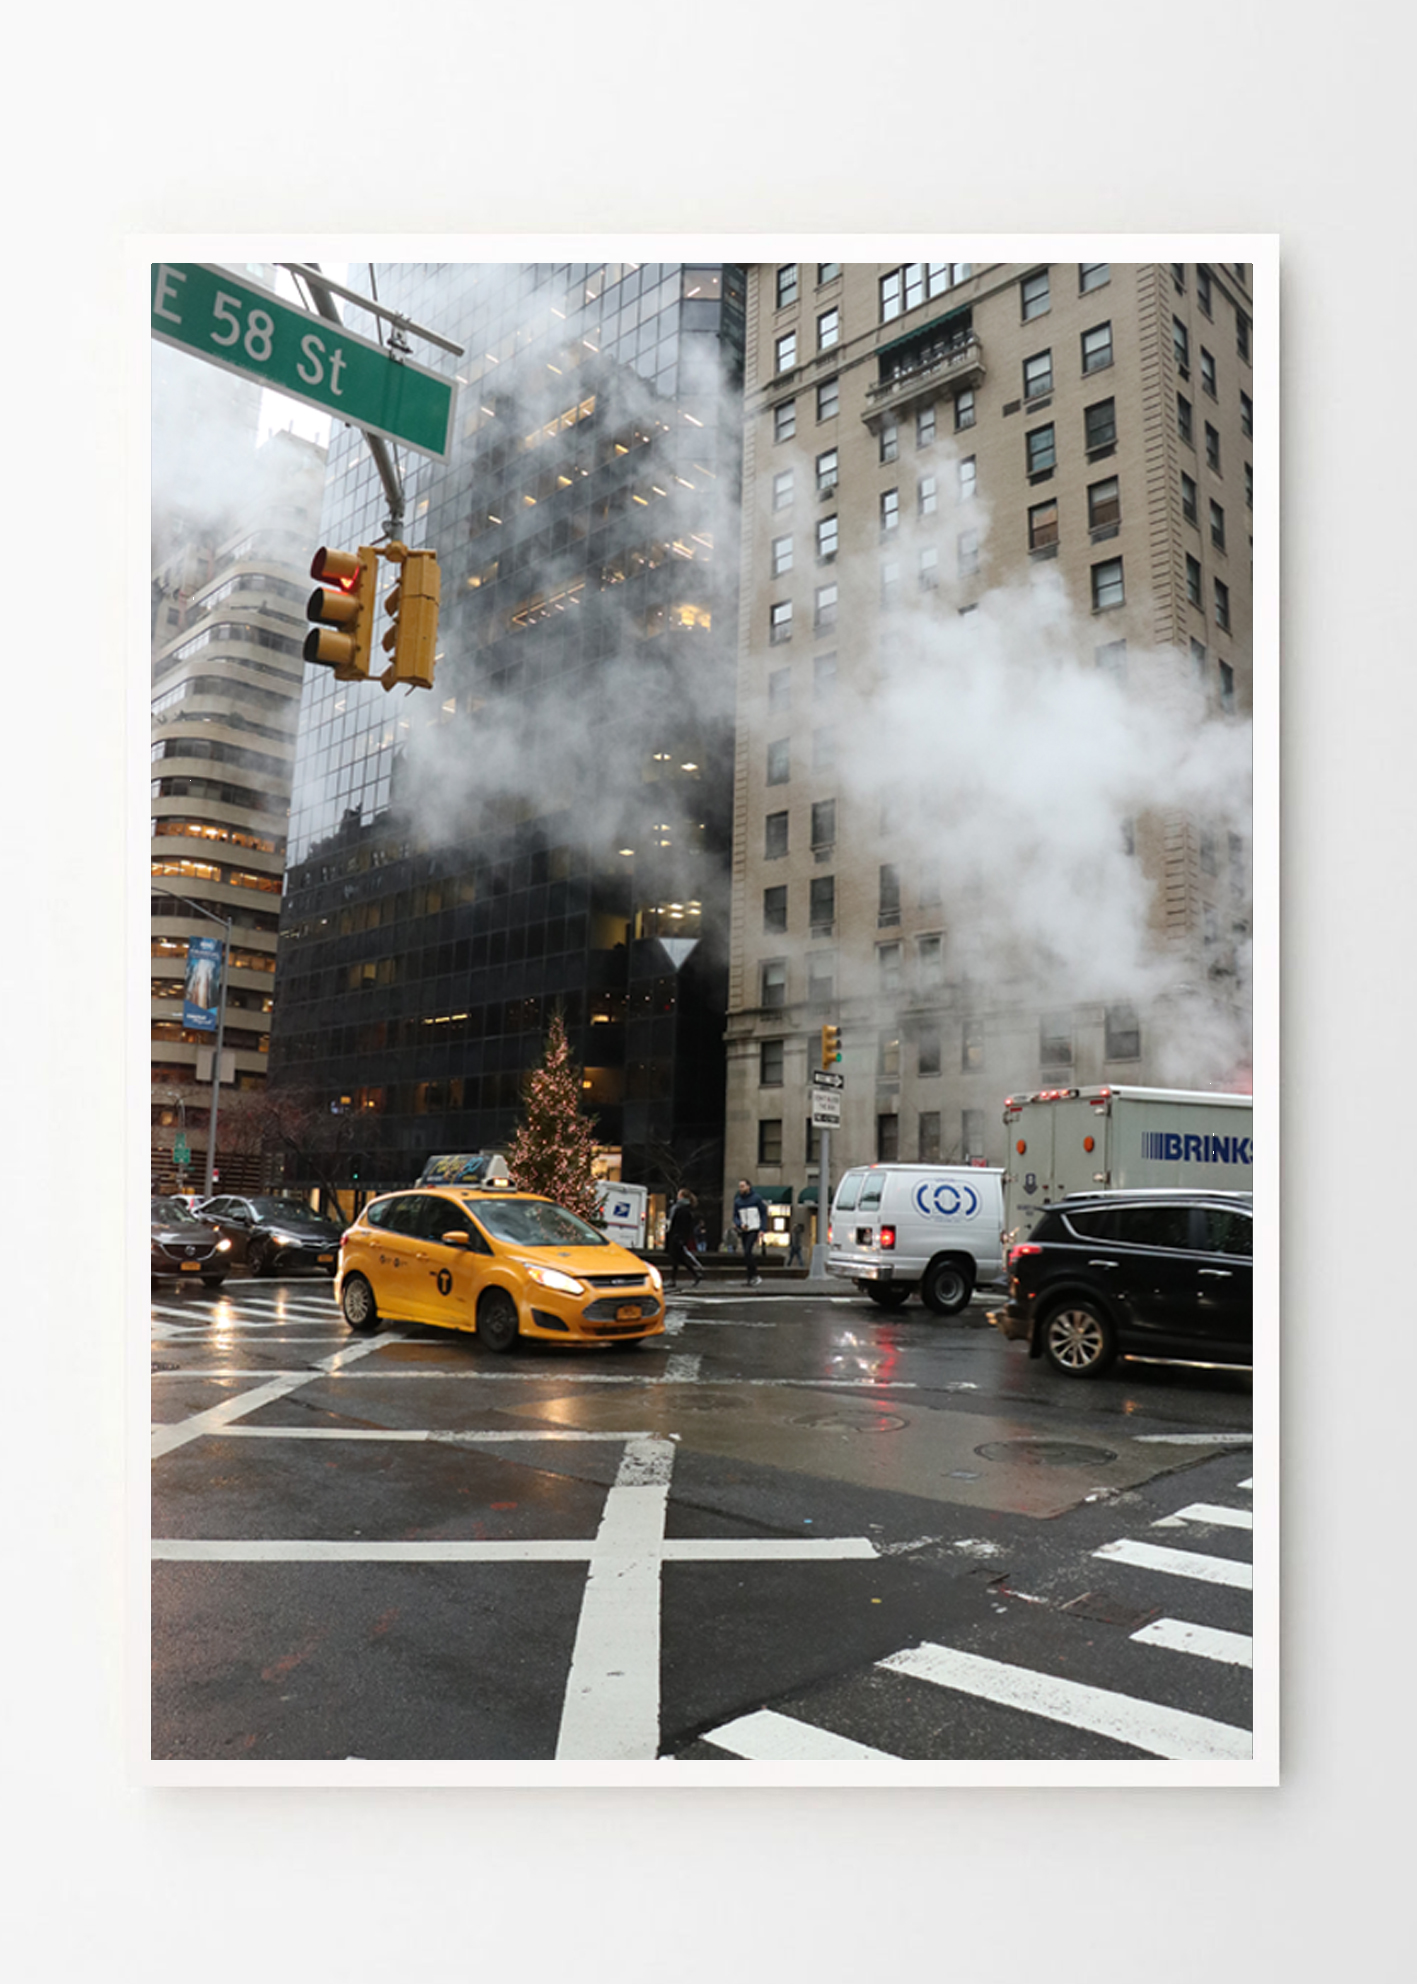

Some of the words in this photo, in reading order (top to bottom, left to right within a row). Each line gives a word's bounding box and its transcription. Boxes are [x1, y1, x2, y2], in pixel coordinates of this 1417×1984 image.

[153, 263, 186, 324] E
[210, 291, 274, 361] 58
[296, 334, 346, 396] St
[1164, 1132, 1253, 1165] BRINK
